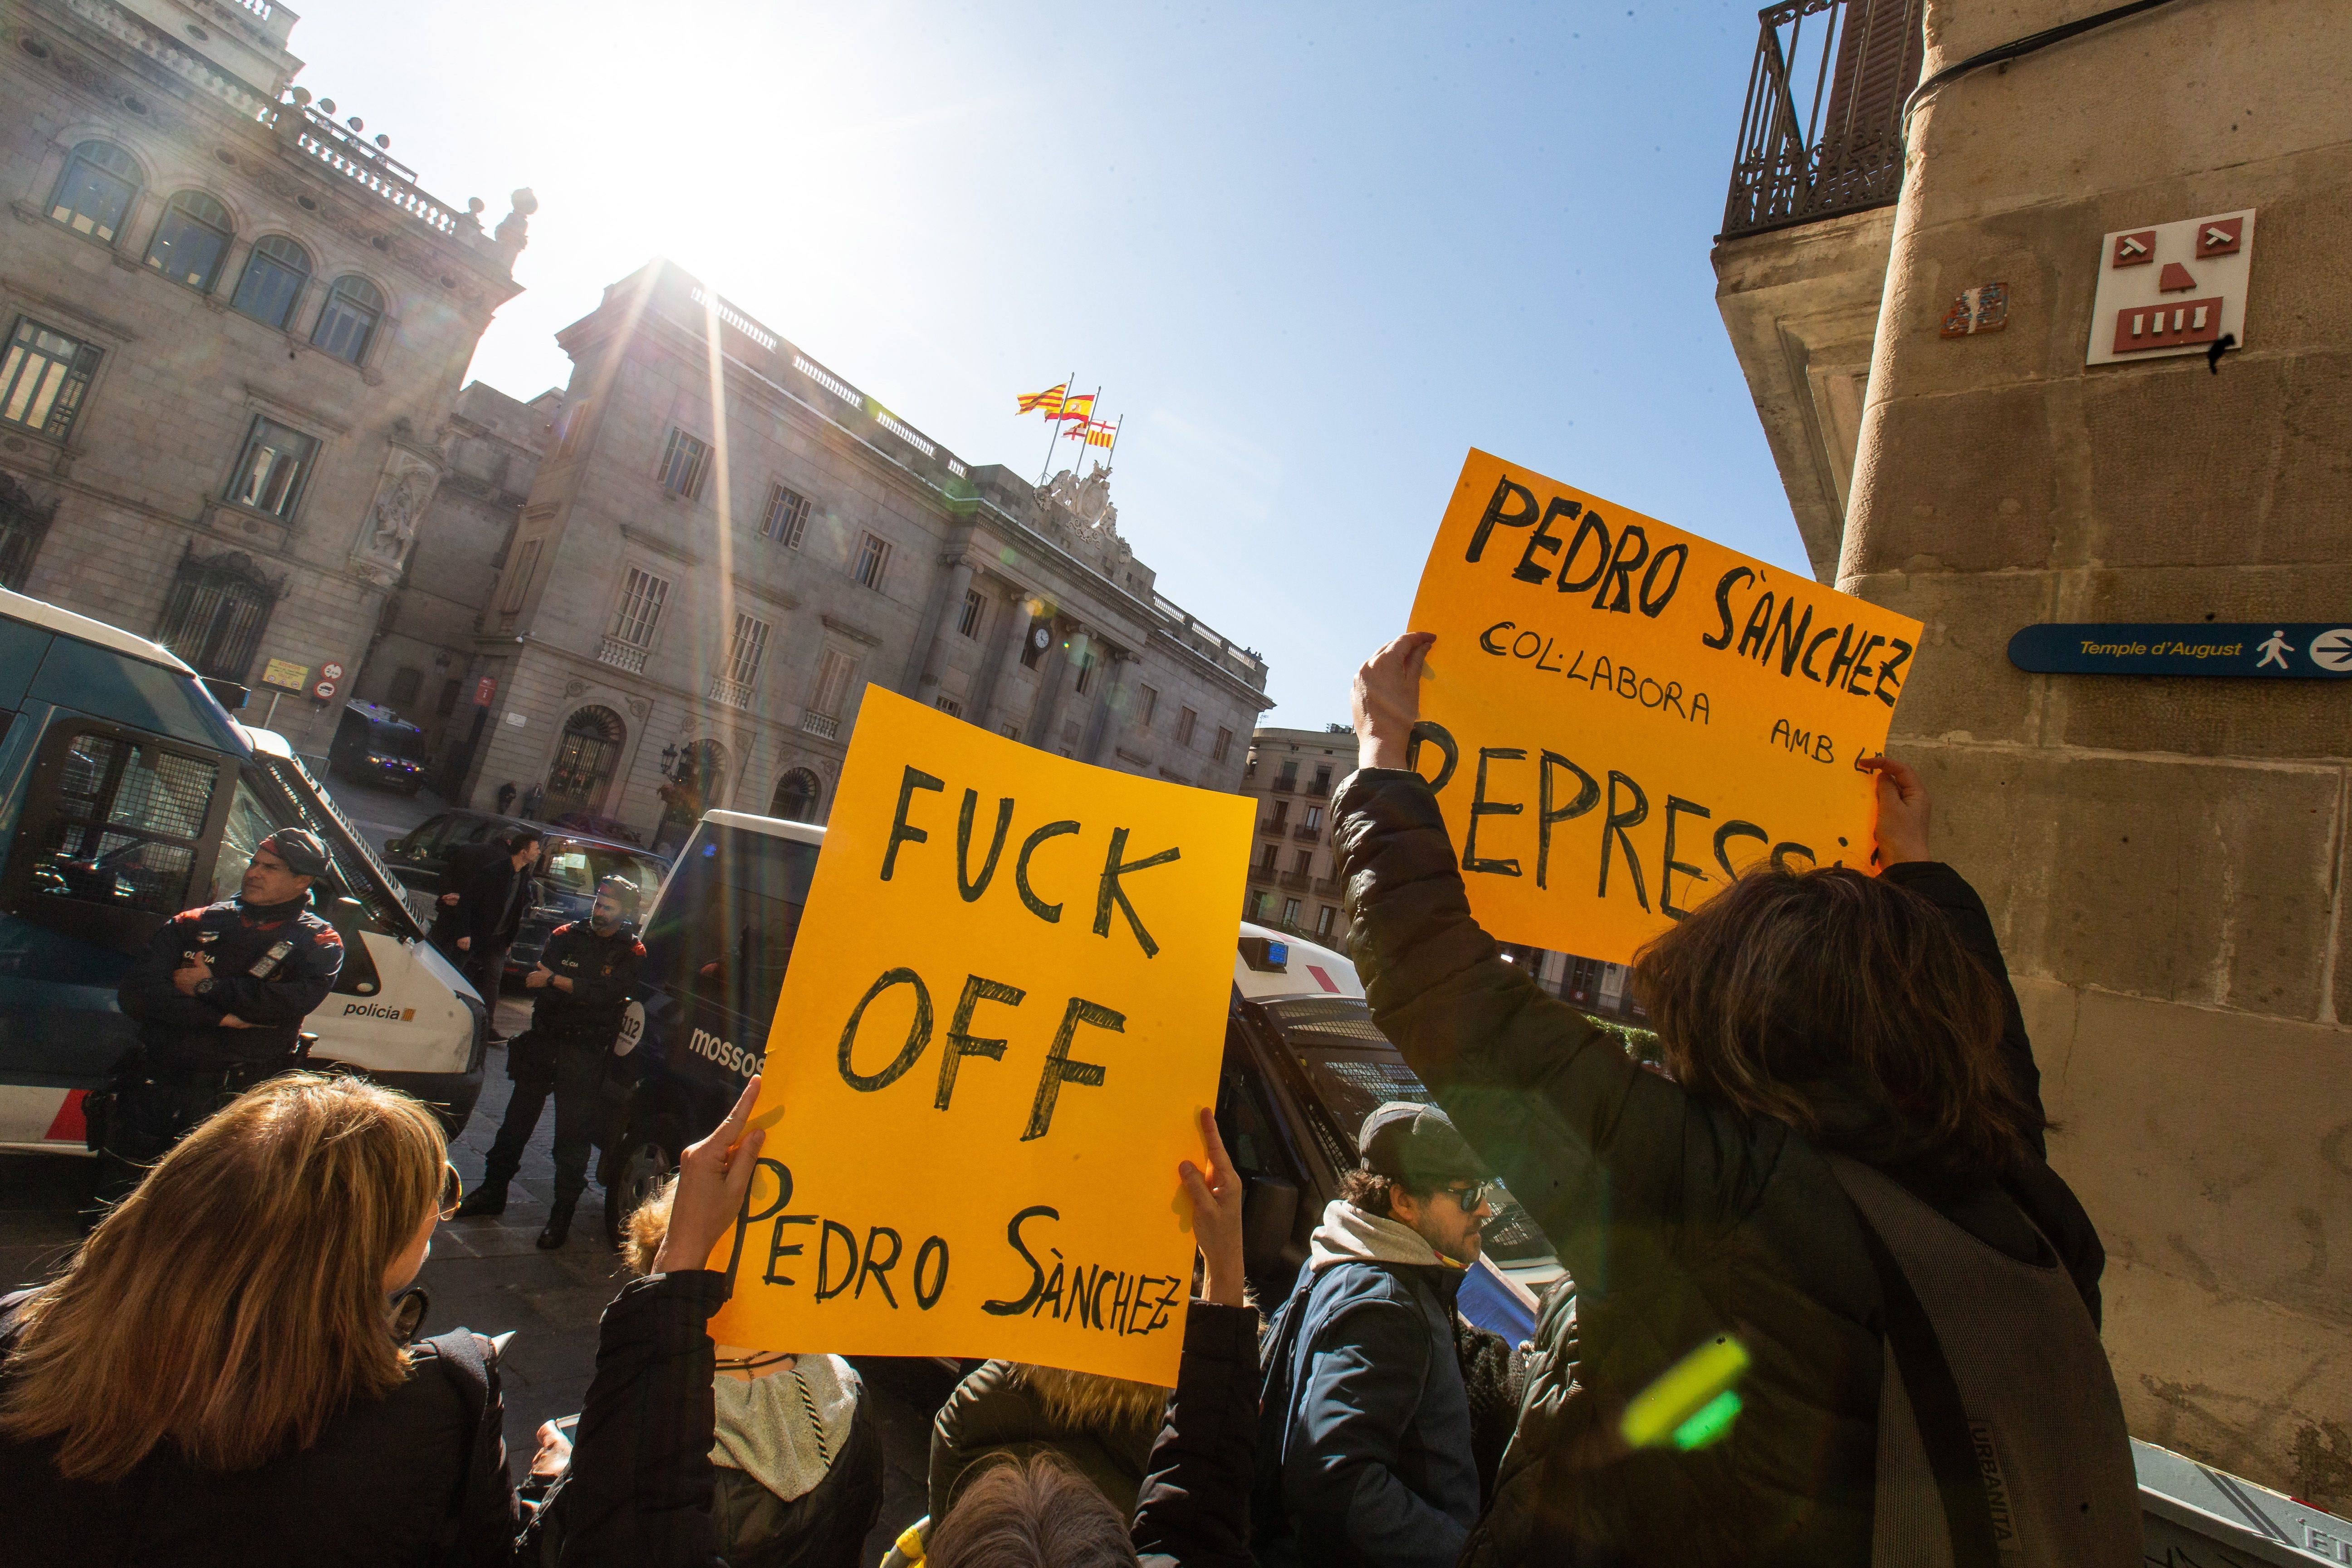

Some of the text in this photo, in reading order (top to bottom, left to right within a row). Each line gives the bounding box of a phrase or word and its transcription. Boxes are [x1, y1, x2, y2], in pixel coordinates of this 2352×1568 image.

[1465, 474, 1689, 619] PEDRO
[2080, 641, 2146, 657] Temple
[1770, 719, 1834, 764] AMB
[880, 765, 1181, 959] FUCK
[343, 1003, 401, 1019] policia
[623, 1015, 640, 1039] 112
[837, 966, 1127, 1142] OFF
[724, 1157, 949, 1311] PEDRO
[1973, 1428, 2012, 1541] URBANITA
